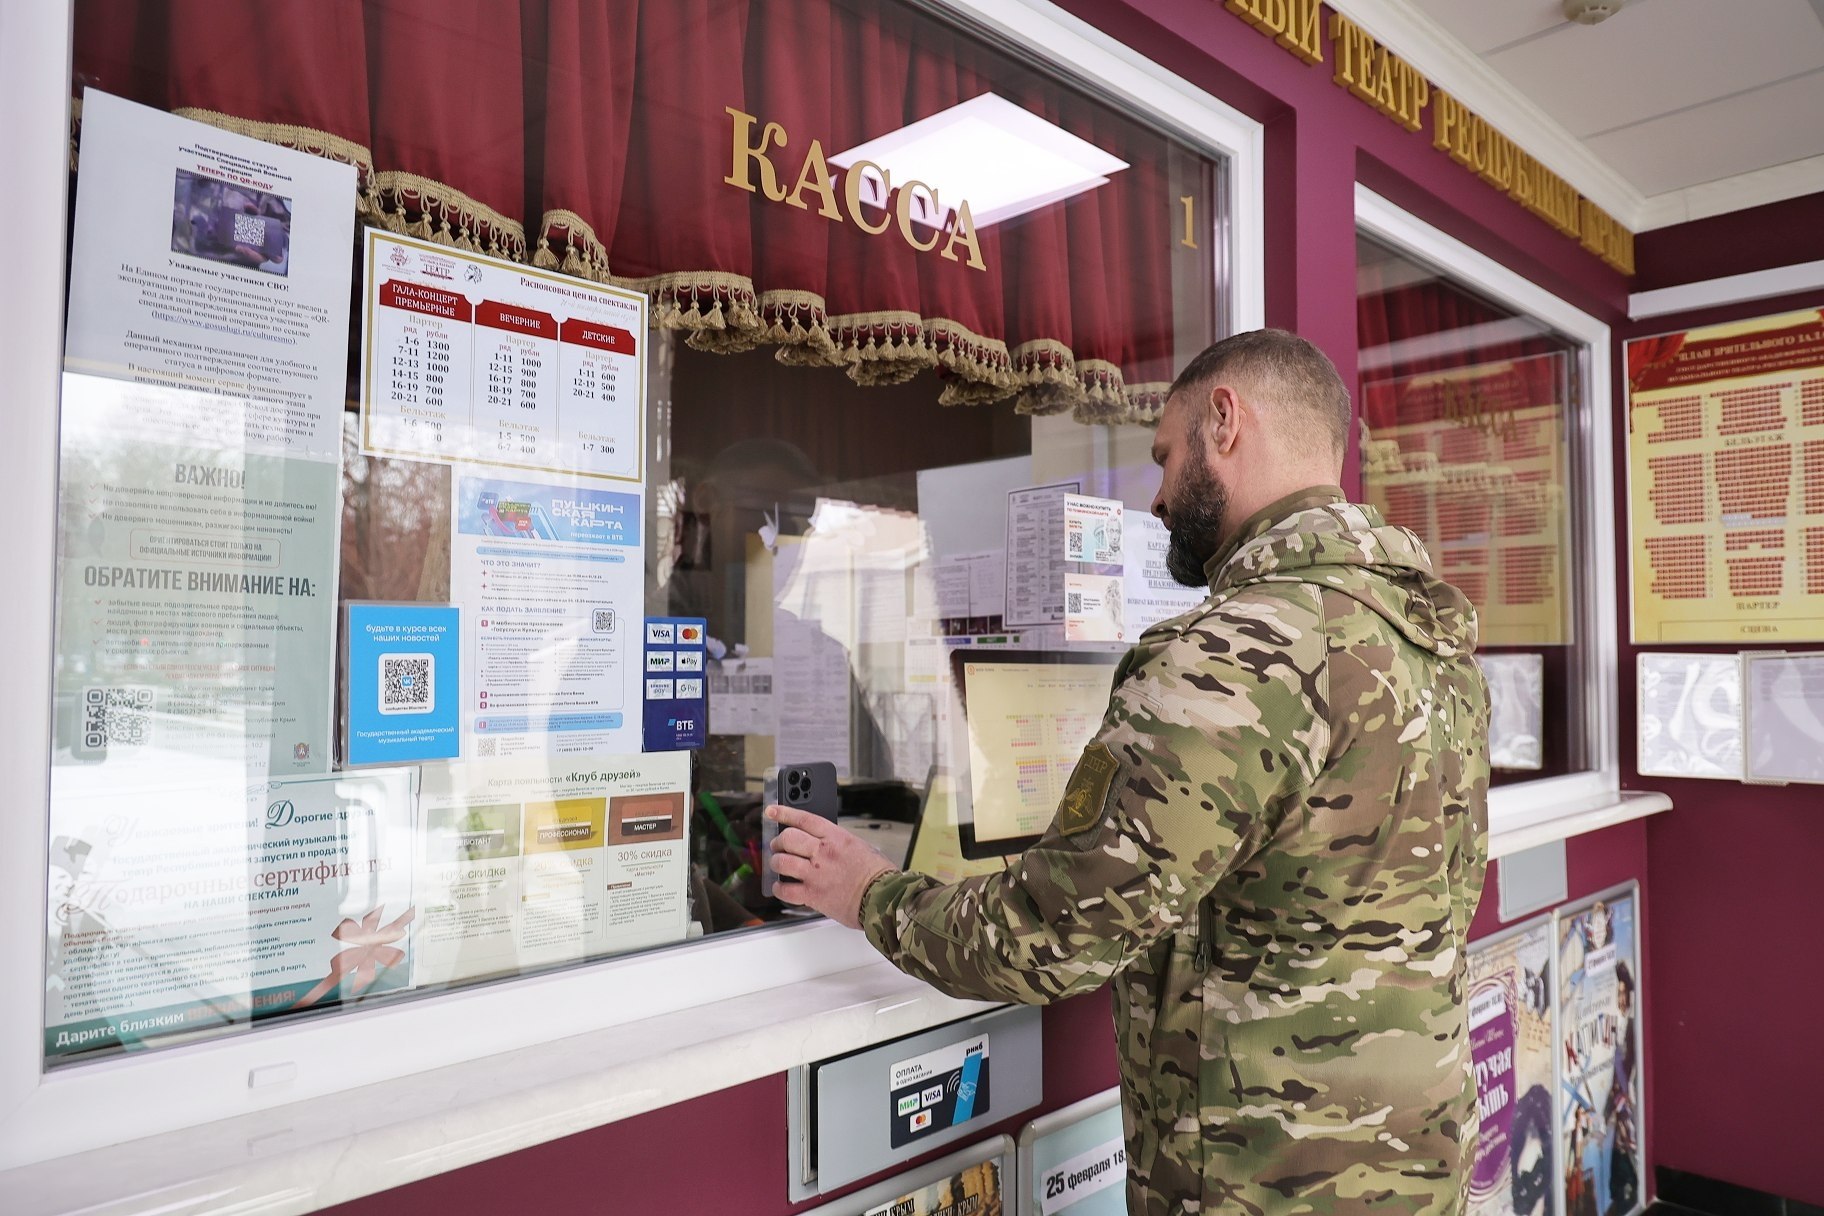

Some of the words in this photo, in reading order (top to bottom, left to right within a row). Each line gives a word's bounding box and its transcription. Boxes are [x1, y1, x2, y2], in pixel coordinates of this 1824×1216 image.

[1329, 12, 1429, 132] ТЕАТР
[252, 162, 277, 171] статуса
[197, 165, 225, 177] ТЕПЕРЬ
[240, 177, 273, 190] QR-КОДУ
[724, 105, 987, 272] КАССА
[1179, 195, 1198, 249] 1
[168, 259, 219, 277] Уважаемые
[221, 271, 265, 287] участники
[267, 280, 289, 292] СВО!
[121, 264, 133, 273] На
[136, 268, 168, 281] Едином
[170, 276, 203, 289] портале
[204, 283, 272, 302] государственных
[274, 297, 295, 308] услуг
[392, 284, 458, 305] ГАЛА-КОНЦЕРТ
[520, 277, 570, 296] Распоясовка
[573, 290, 587, 300] цен
[599, 297, 638, 312] спектакли
[396, 296, 455, 316] ПРЕМЬЕРНЫЕ
[409, 315, 443, 329] Партер
[500, 313, 540, 329] ВЕЧЕРНИЕ
[404, 326, 417, 334] ряд
[427, 331, 448, 339] рубли
[583, 330, 615, 344] ДЕТСКИЕ
[405, 336, 419, 346] 1-6
[427, 341, 450, 351] 1300
[506, 335, 536, 348] Партер
[398, 346, 418, 356] 7-11
[427, 351, 449, 362] 1200
[499, 344, 511, 352] ряд
[521, 348, 540, 356] рубли
[586, 351, 613, 363] Партер
[393, 357, 419, 368] 12-13
[427, 363, 449, 373] 1000
[495, 353, 512, 363] 1-11
[522, 358, 541, 368] 1000
[583, 360, 594, 368] ряд
[601, 363, 619, 372] рубли
[392, 369, 418, 380] 14-15
[426, 374, 443, 384] 800
[489, 363, 512, 374] 12-15
[521, 369, 536, 378] 900
[579, 369, 595, 378] 1-11
[602, 373, 615, 381] 600
[392, 380, 418, 391] 16-19
[426, 386, 443, 395] 700
[489, 374, 512, 384] 16-17
[521, 380, 536, 389] 800
[574, 378, 595, 388] 12-19
[601, 383, 615, 392] 500
[392, 391, 417, 403] 20-21
[426, 398, 443, 406] 600
[489, 385, 512, 395] 18-19
[521, 390, 536, 399] 700
[573, 388, 594, 399] 20-21
[601, 393, 615, 402] 400
[488, 396, 511, 406] 20-21
[520, 401, 536, 410] 600
[401, 405, 446, 419] Бельэтаж
[499, 420, 540, 432] Бельэтаж
[499, 432, 512, 440] 1-5
[520, 434, 535, 443] 500
[579, 432, 615, 444] Бельэтаж
[498, 443, 511, 451] 6-7
[520, 445, 535, 454] 400
[601, 446, 614, 454] 300
[175, 463, 246, 489] ВАЖНО!
[552, 499, 623, 514] ПУШКИН
[552, 508, 595, 519] СКАЯ
[571, 518, 623, 530] КАРТА
[611, 533, 623, 541] ВТБ
[84, 565, 183, 590] ОБРАТИТЕ
[188, 571, 284, 595] ВНИМАНИЕ
[289, 577, 316, 597] НА:
[366, 624, 394, 633] будьте
[402, 634, 440, 642] новостей
[687, 658, 697, 666] Pay
[676, 720, 694, 731] ВТБ
[357, 729, 409, 738] Государственный
[566, 771, 597, 783] «Клуб
[600, 769, 640, 782] друзей»
[264, 799, 332, 829] Дорогие
[634, 823, 656, 831] МАСТЕР
[539, 828, 589, 841] ПРОФЕССИОНАЛ
[618, 850, 638, 862] 30%
[641, 848, 672, 860] скидка
[468, 867, 506, 879] скидка
[56, 1025, 116, 1047] Дарите
[120, 1013, 184, 1033] близким
[966, 1041, 983, 1056] рнкб
[896, 1064, 922, 1079] ОПЛАТА
[900, 1076, 913, 1085] одно
[913, 1070, 932, 1080] касание
[925, 1090, 941, 1102] VISA
[899, 1098, 918, 1112] МИР
[1047, 1171, 1065, 1199] 25
[1068, 1158, 1110, 1190] февраля
